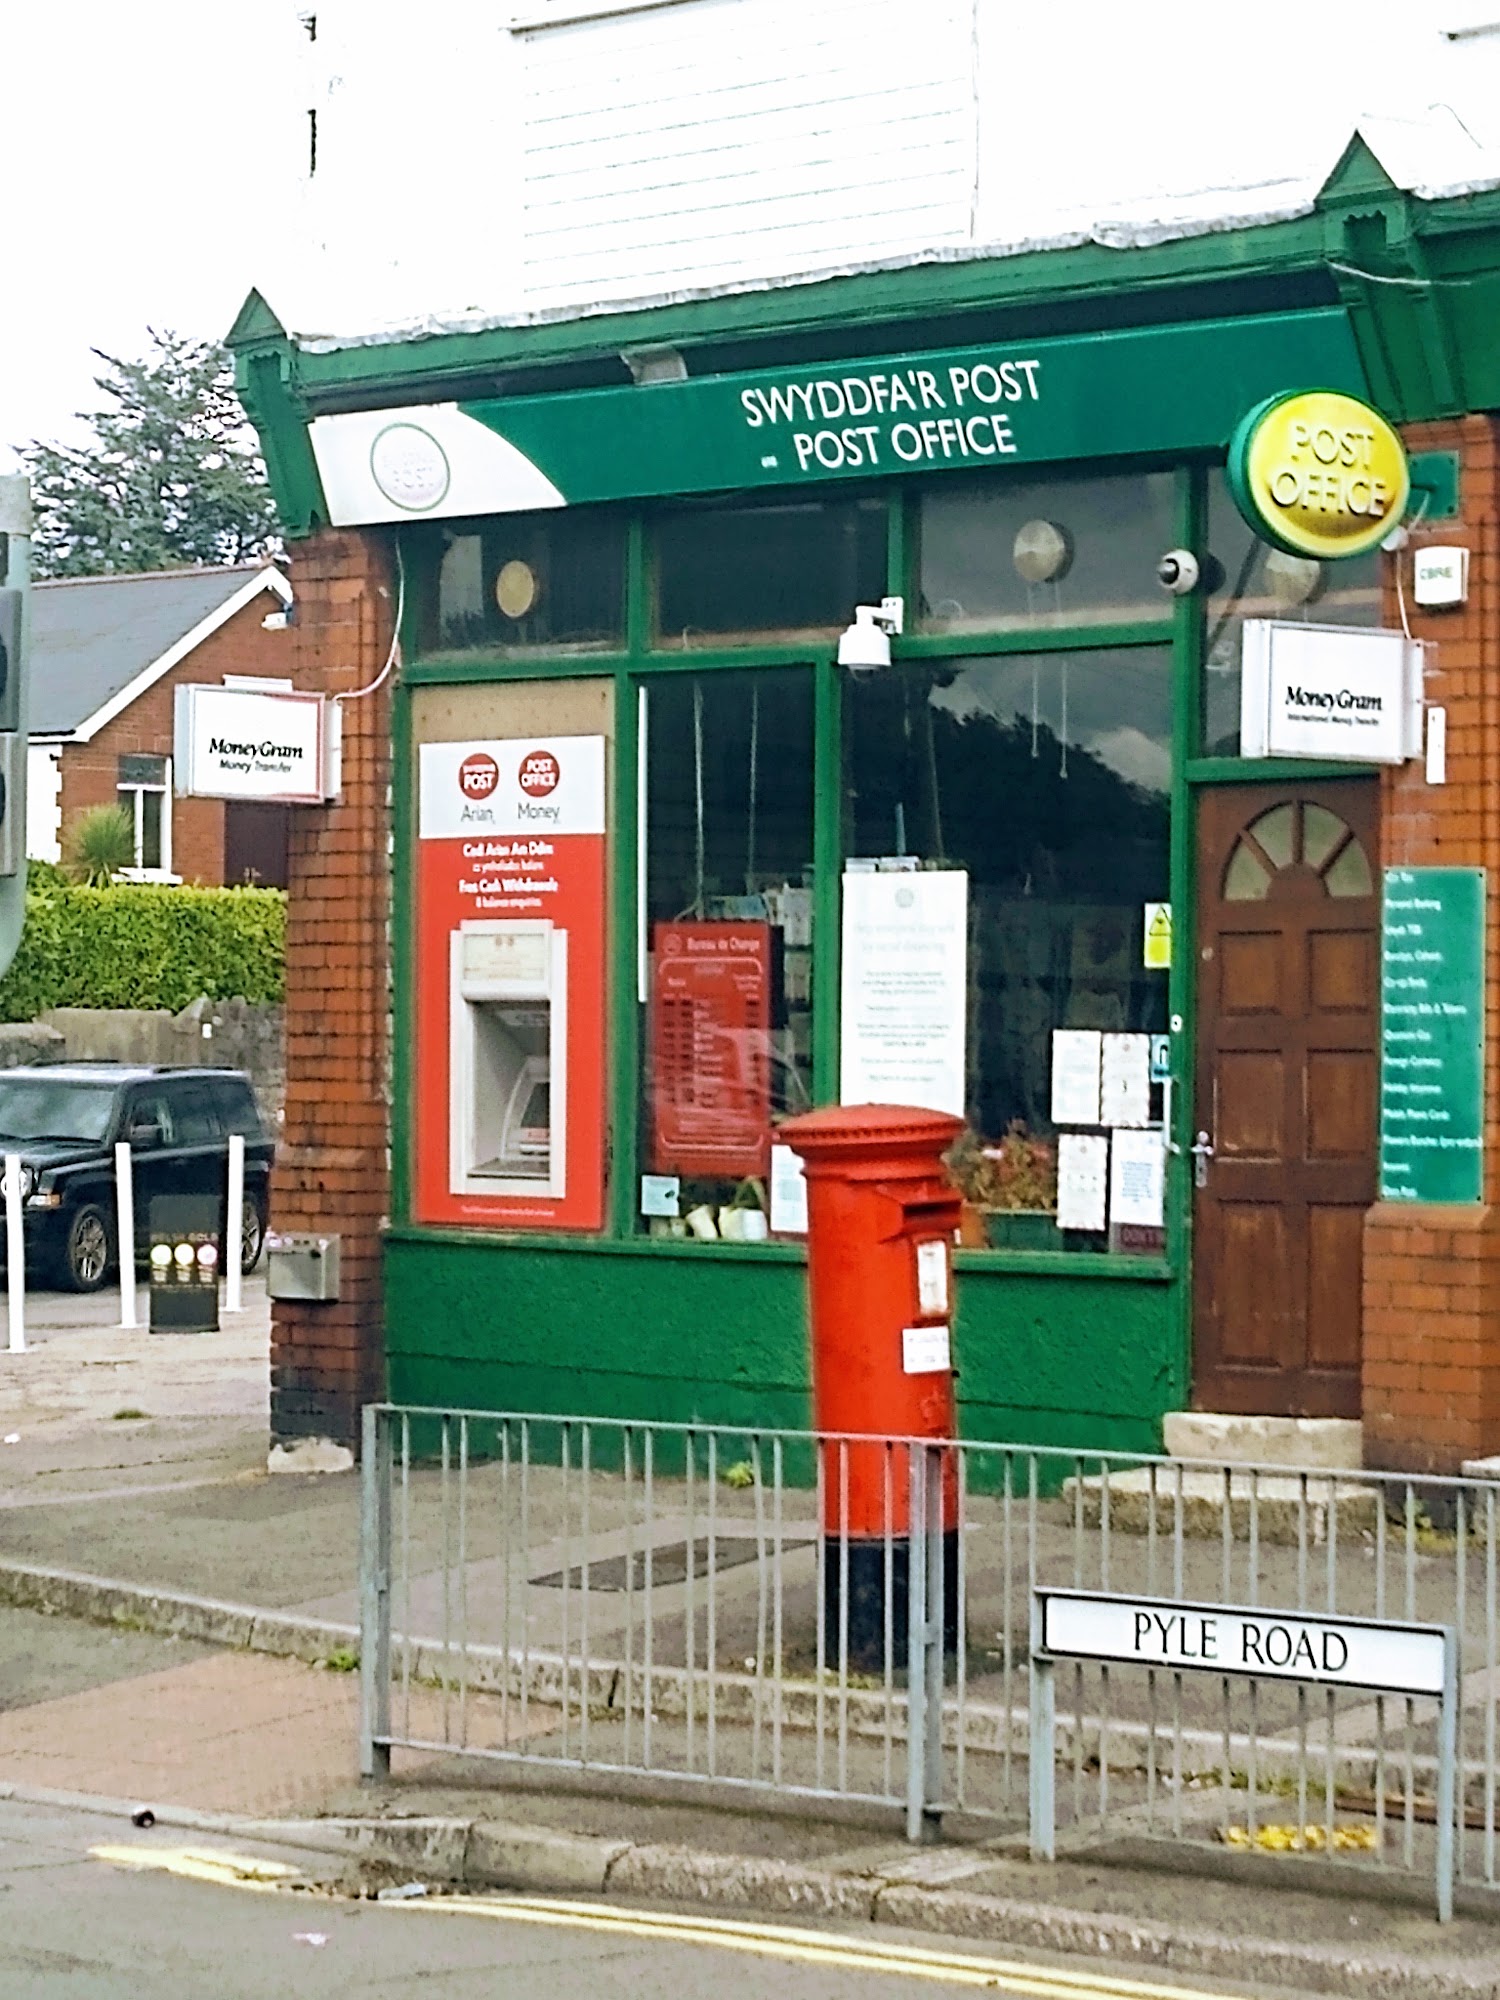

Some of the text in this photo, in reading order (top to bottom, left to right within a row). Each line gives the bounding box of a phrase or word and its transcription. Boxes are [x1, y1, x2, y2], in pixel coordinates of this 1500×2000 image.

[741, 360, 1040, 427] SWYDDFA'R POST
[793, 414, 1018, 471] POST OFFICE
[1292, 423, 1375, 470] POST
[1270, 471, 1387, 519] OFFICE
[1285, 686, 1382, 712] MoneyGram
[209, 738, 303, 760] MoneyGram
[526, 759, 554, 773] POST
[463, 773, 495, 790] POST
[520, 772, 556, 788] OFFICE
[1133, 1612, 1349, 1672] PYLE ROAD
